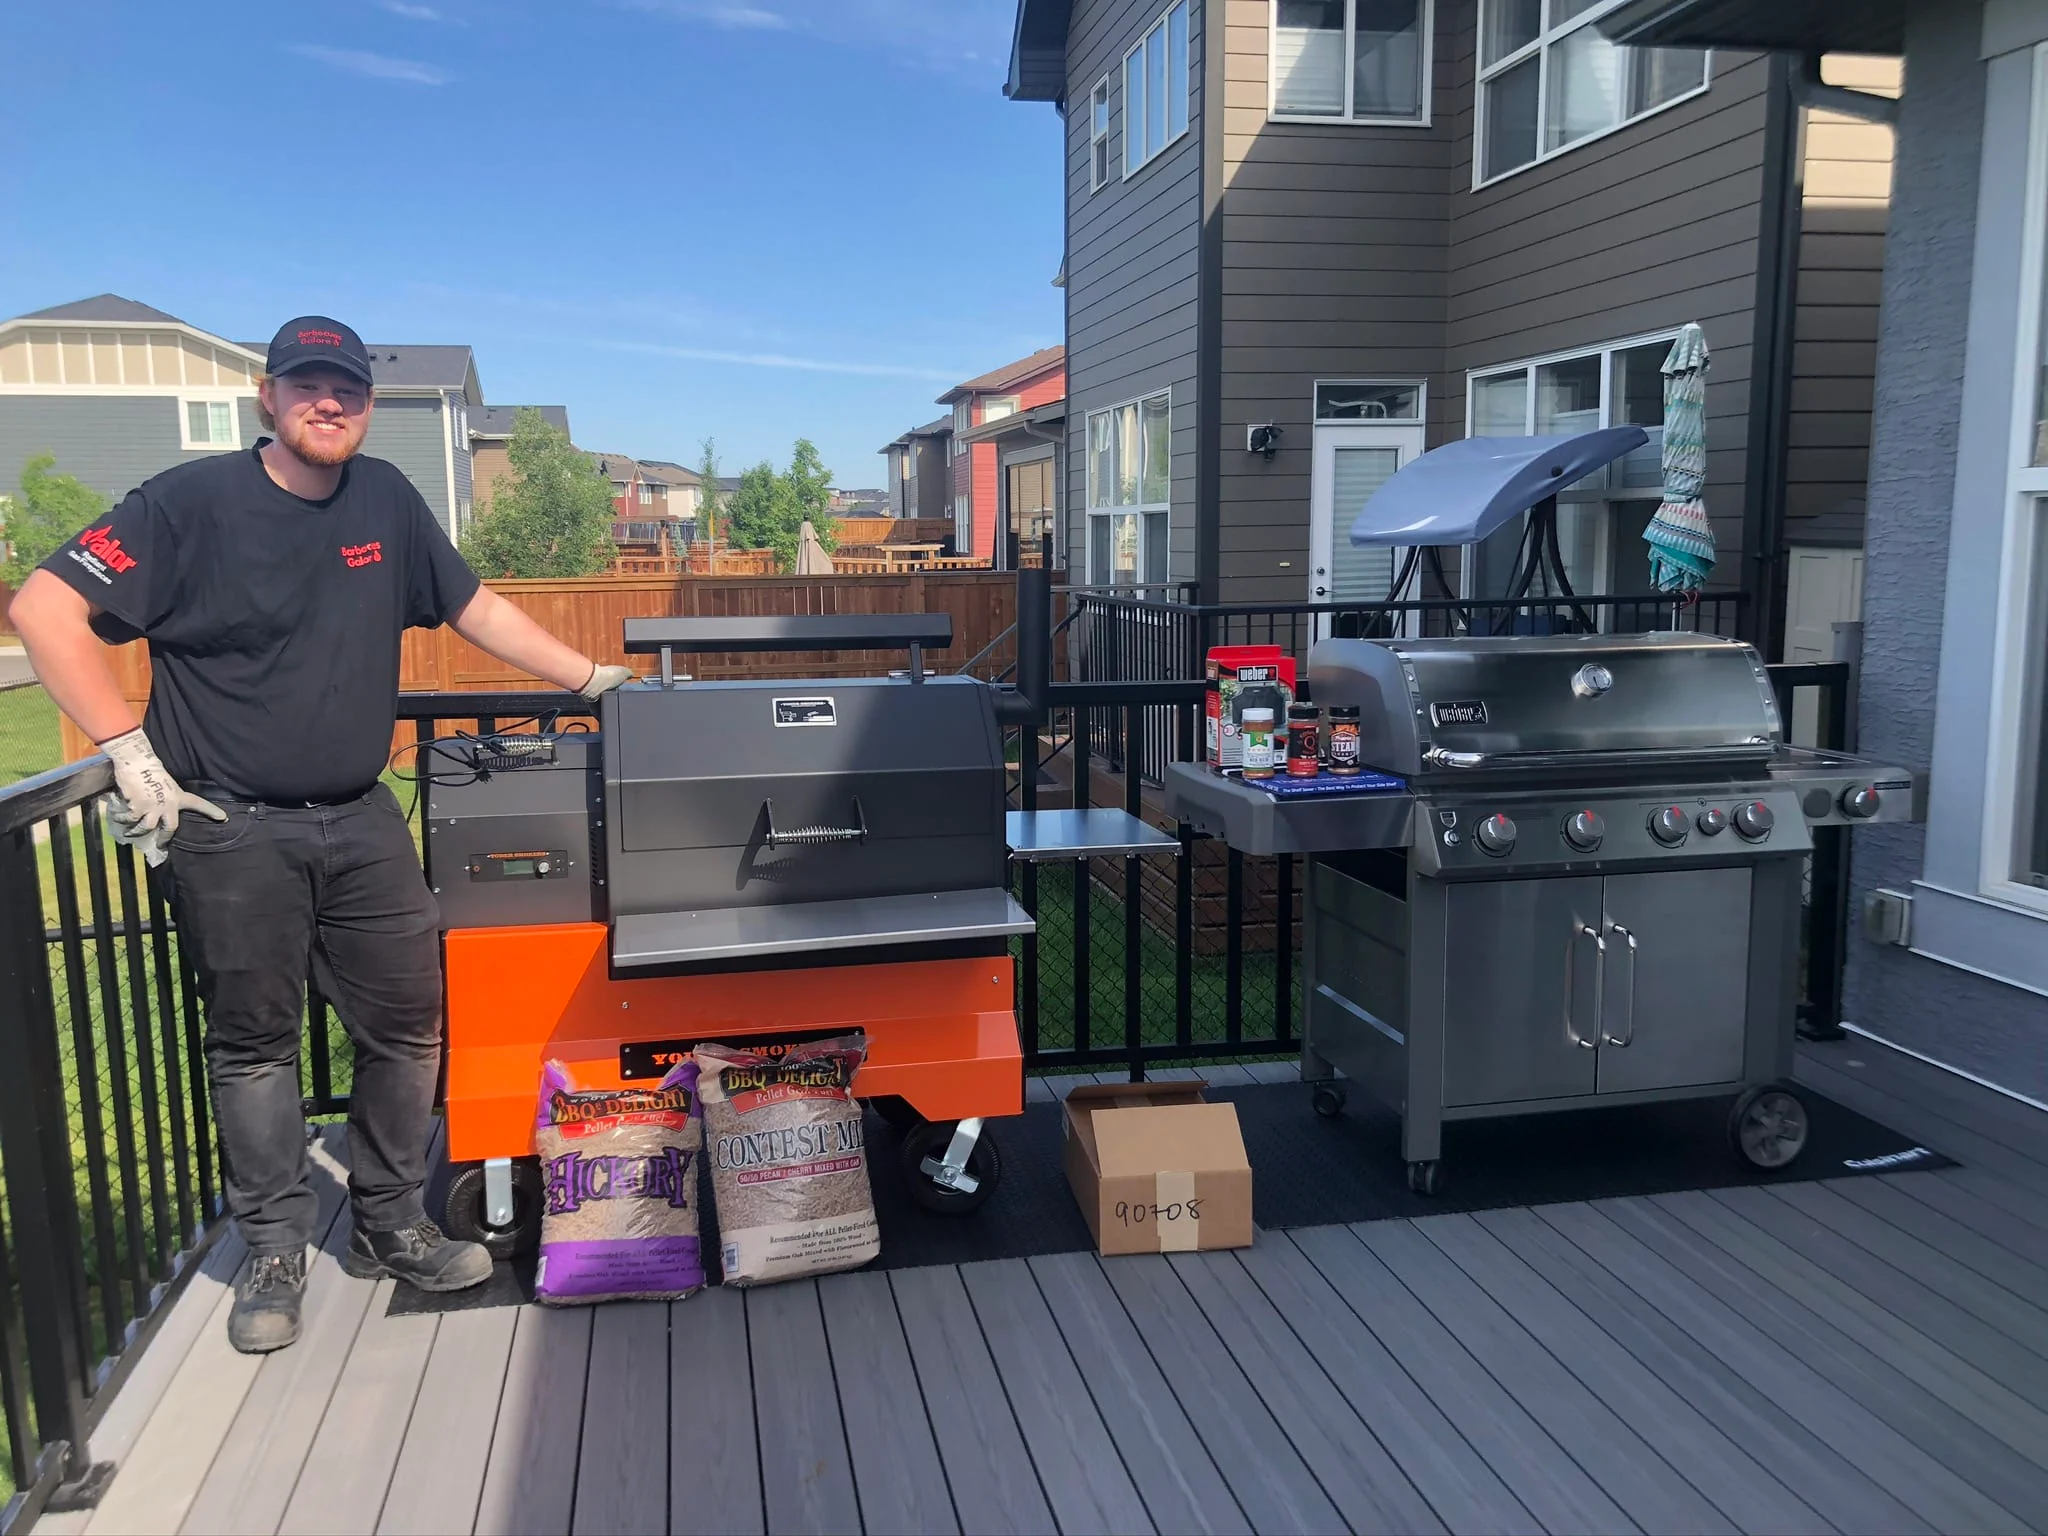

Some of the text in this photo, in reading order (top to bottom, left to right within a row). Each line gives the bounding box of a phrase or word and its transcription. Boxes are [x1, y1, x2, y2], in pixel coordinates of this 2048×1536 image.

[79, 525, 137, 574] Valor
[1240, 667, 1268, 681] weber
[140, 769, 166, 806] HyFlex
[756, 1088, 783, 1104] Pellet
[584, 1119, 613, 1134] Pellet
[716, 1122, 830, 1170] CONTEST
[546, 1146, 694, 1216] HICKORY
[759, 1170, 781, 1181] PECAN
[788, 1164, 813, 1177] CHERRY
[814, 1161, 834, 1174] MIXED
[769, 1231, 811, 1244] Recommended
[824, 1228, 837, 1237] ALL
